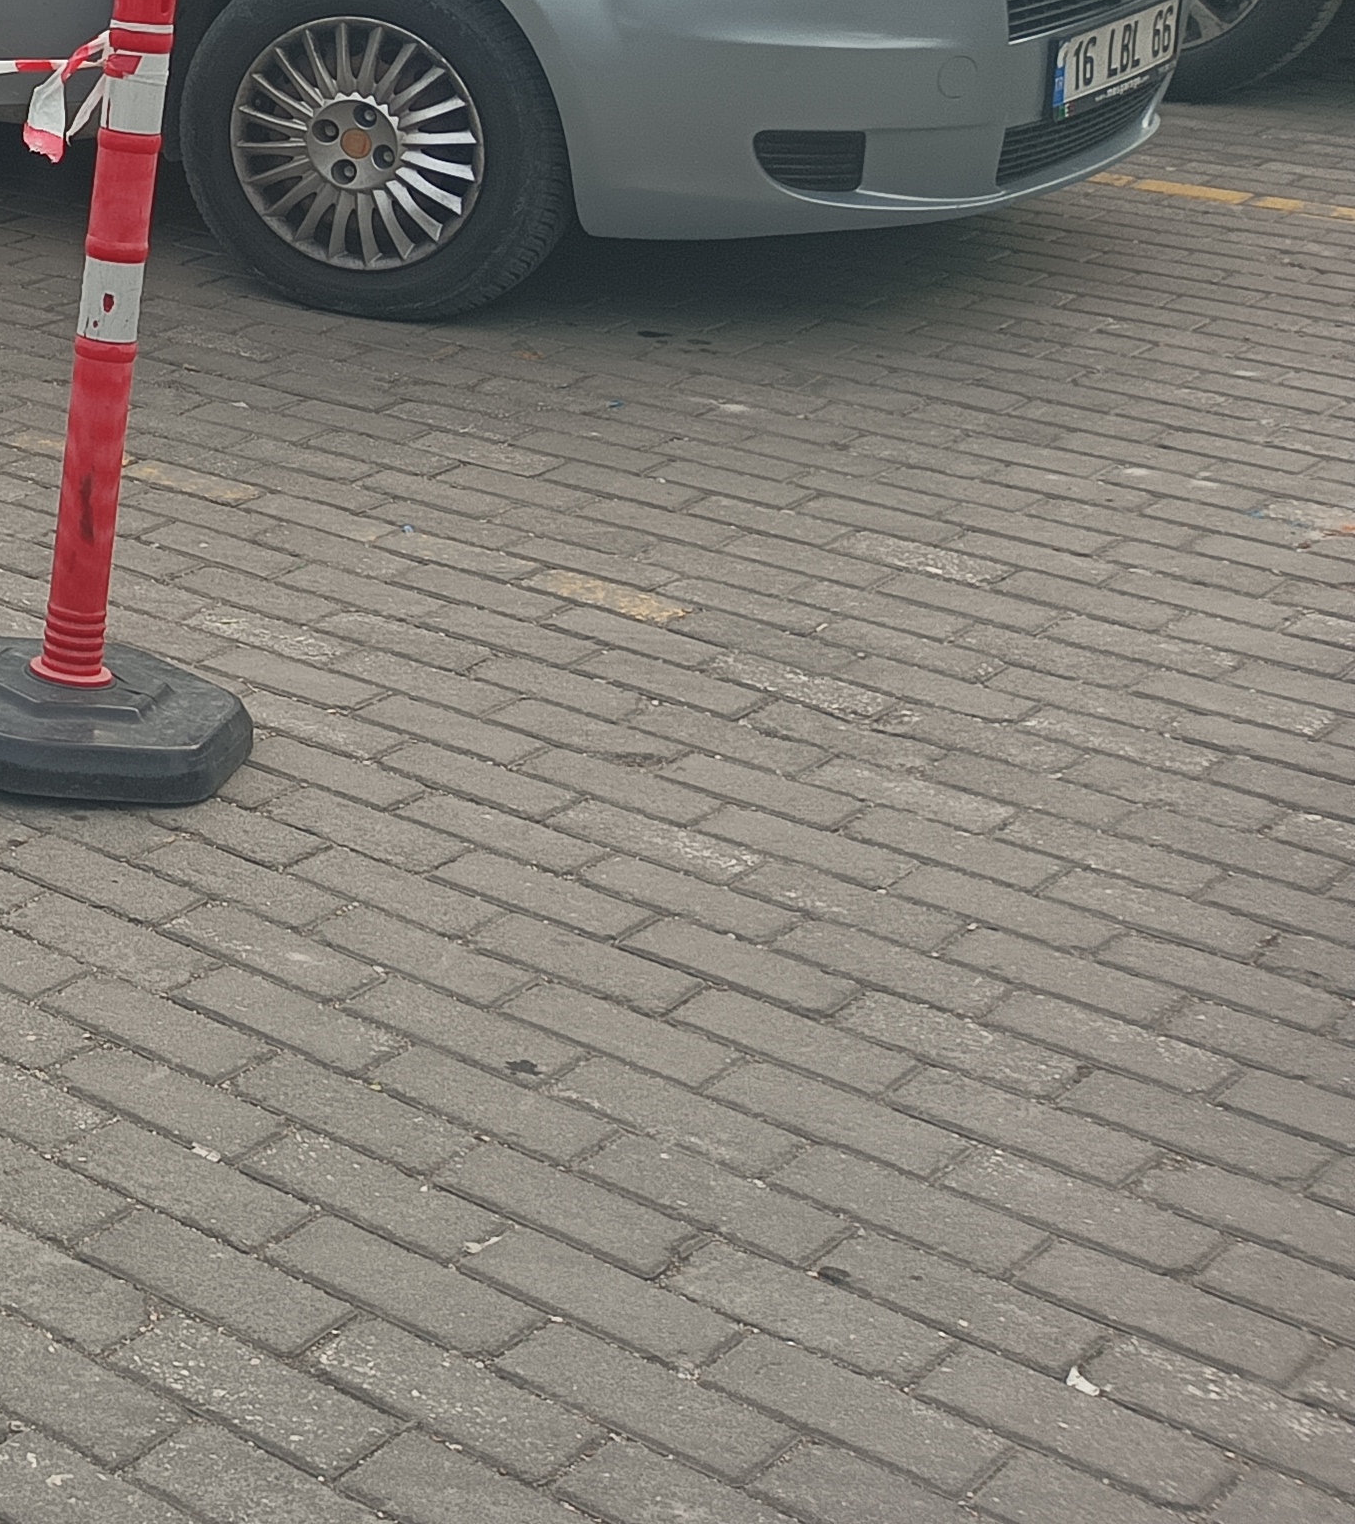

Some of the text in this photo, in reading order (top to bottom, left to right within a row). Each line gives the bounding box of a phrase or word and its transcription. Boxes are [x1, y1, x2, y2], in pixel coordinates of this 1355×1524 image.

[1074, 35, 1098, 91] 16
[1106, 19, 1141, 80] LBL
[1151, 4, 1175, 59] 66
